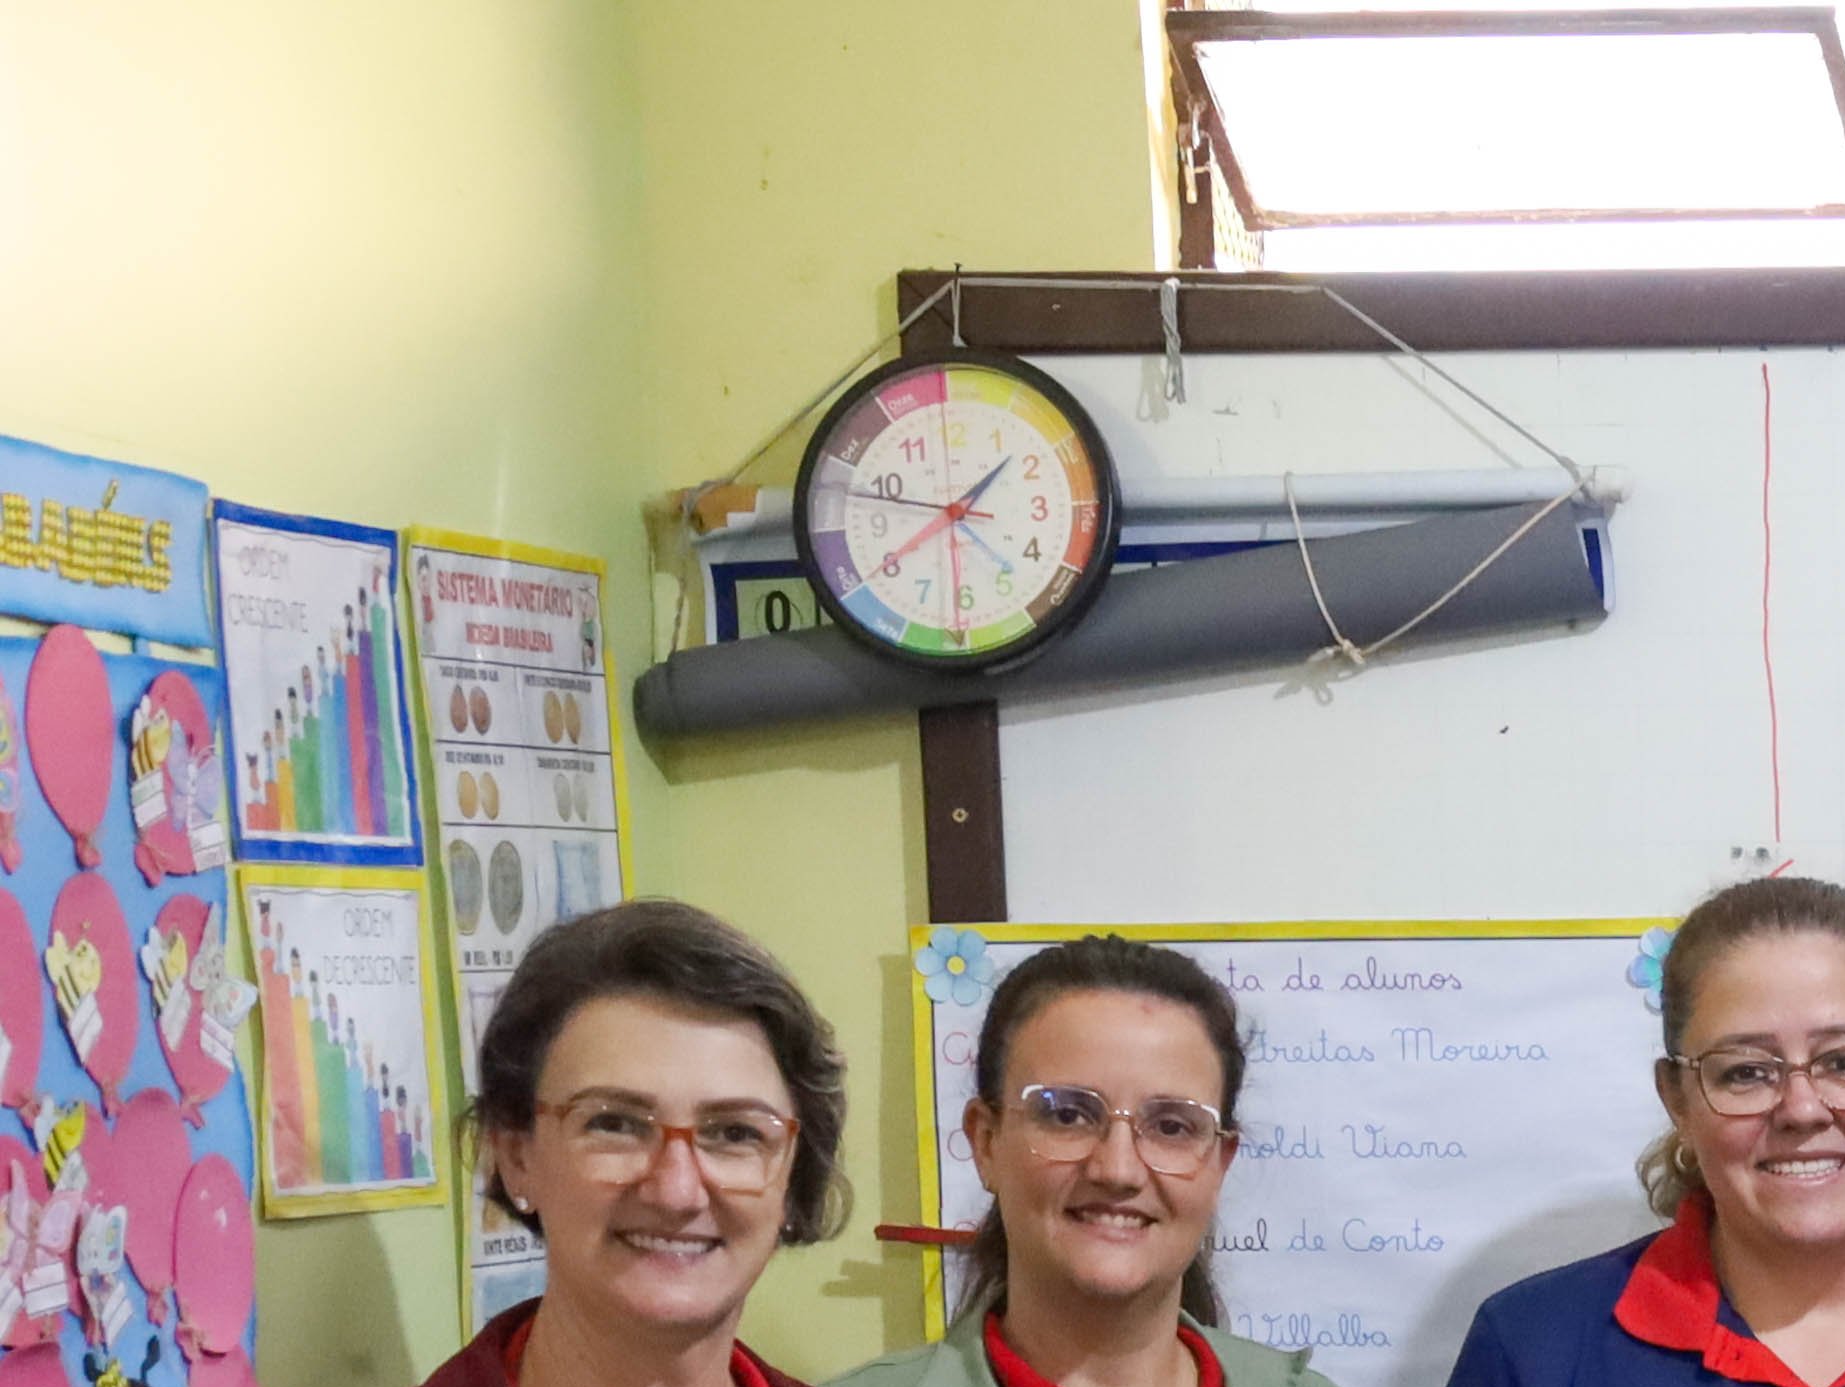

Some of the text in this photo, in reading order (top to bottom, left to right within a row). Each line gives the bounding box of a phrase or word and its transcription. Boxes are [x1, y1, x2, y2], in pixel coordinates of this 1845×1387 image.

[898, 436, 925, 464] 11
[1022, 454, 1041, 480] 2
[870, 472, 903, 500] 10
[1030, 495, 1049, 521] 3
[870, 512, 888, 538] 9
[1022, 536, 1042, 562] 4
[883, 552, 901, 578] 8
[436, 569, 499, 608] SISTEMA
[914, 579, 932, 605] 7
[957, 584, 975, 610] 6
[995, 569, 1014, 597] 5
[344, 906, 393, 938] ORDEM
[1282, 956, 1324, 991] de
[1340, 956, 1463, 991] alunos
[1391, 1028, 1550, 1062] Moreira
[1341, 1124, 1467, 1159] Viana
[1204, 1218, 1445, 1252] nuel de Conto
[1238, 1313, 1392, 1348] Villalba
